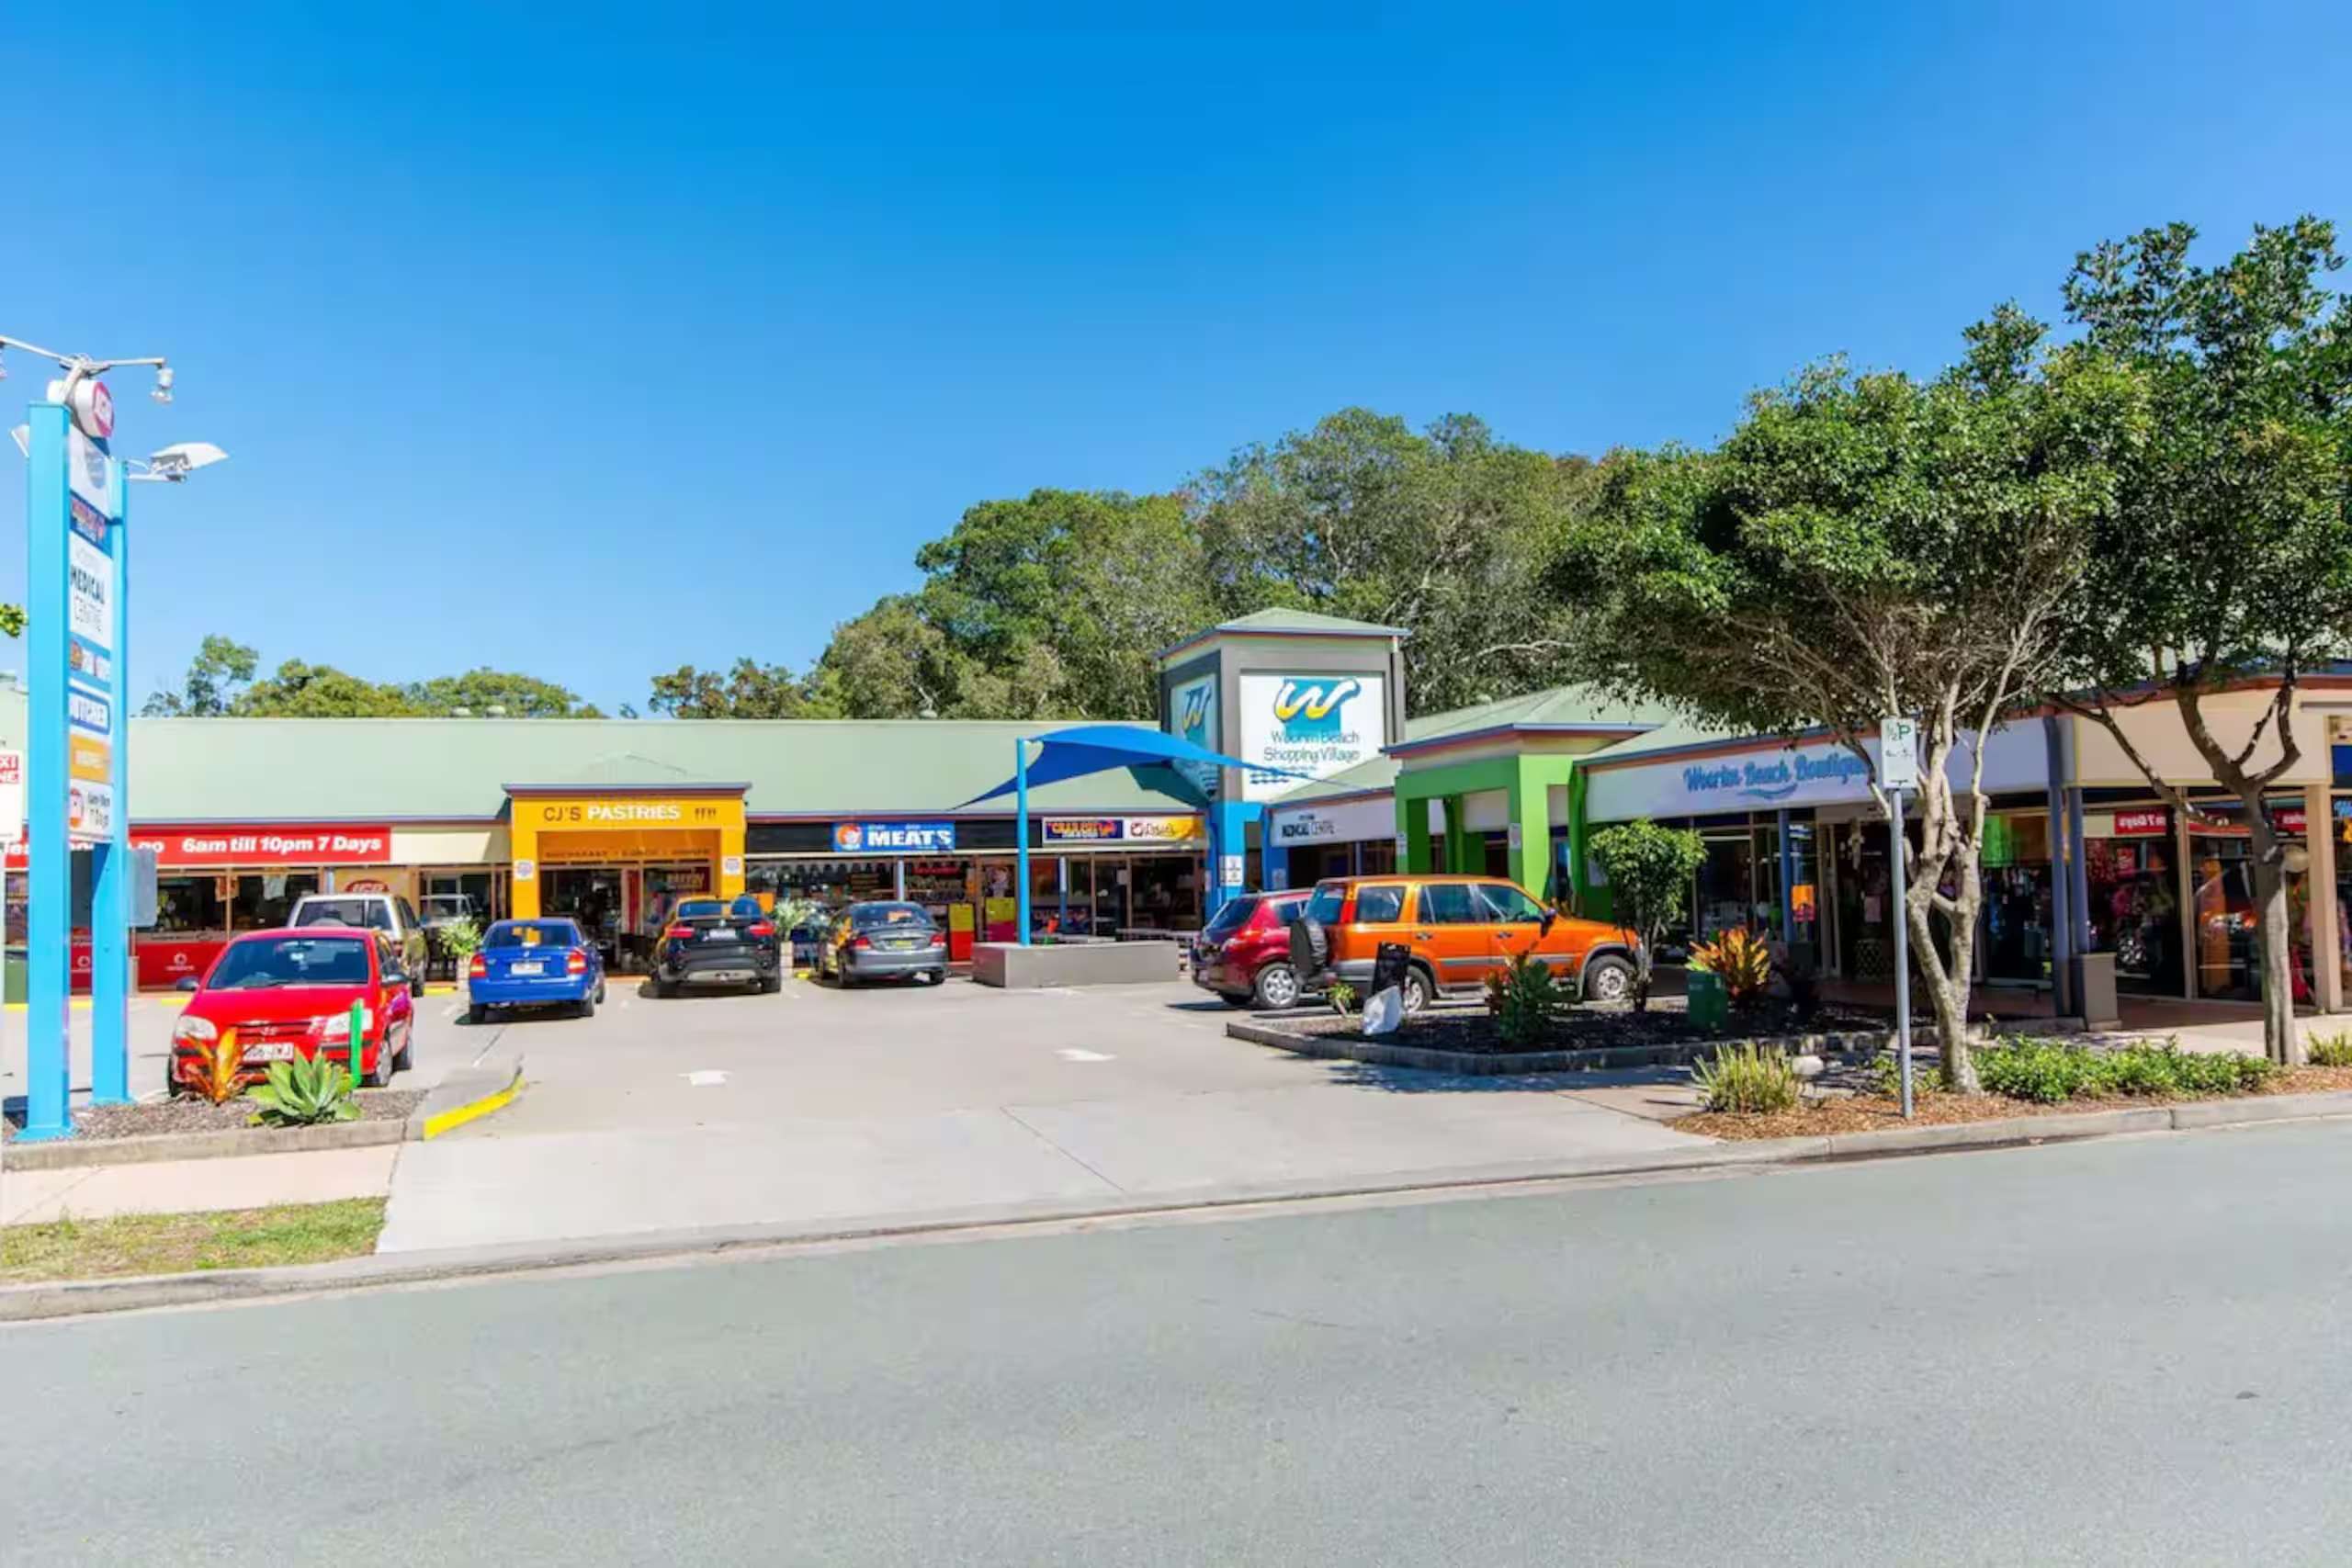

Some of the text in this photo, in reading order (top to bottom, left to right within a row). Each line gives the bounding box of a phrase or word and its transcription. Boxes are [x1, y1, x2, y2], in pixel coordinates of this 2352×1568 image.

[1264, 747, 1361, 763] Shopping Village
[543, 805, 681, 821] CJ'S PASTRIES
[182, 838, 226, 852] 6am
[230, 837, 256, 851] till
[260, 836, 313, 854] 10pm
[317, 837, 330, 851] 7
[332, 835, 381, 852] Days
[867, 829, 952, 846] MEATS
